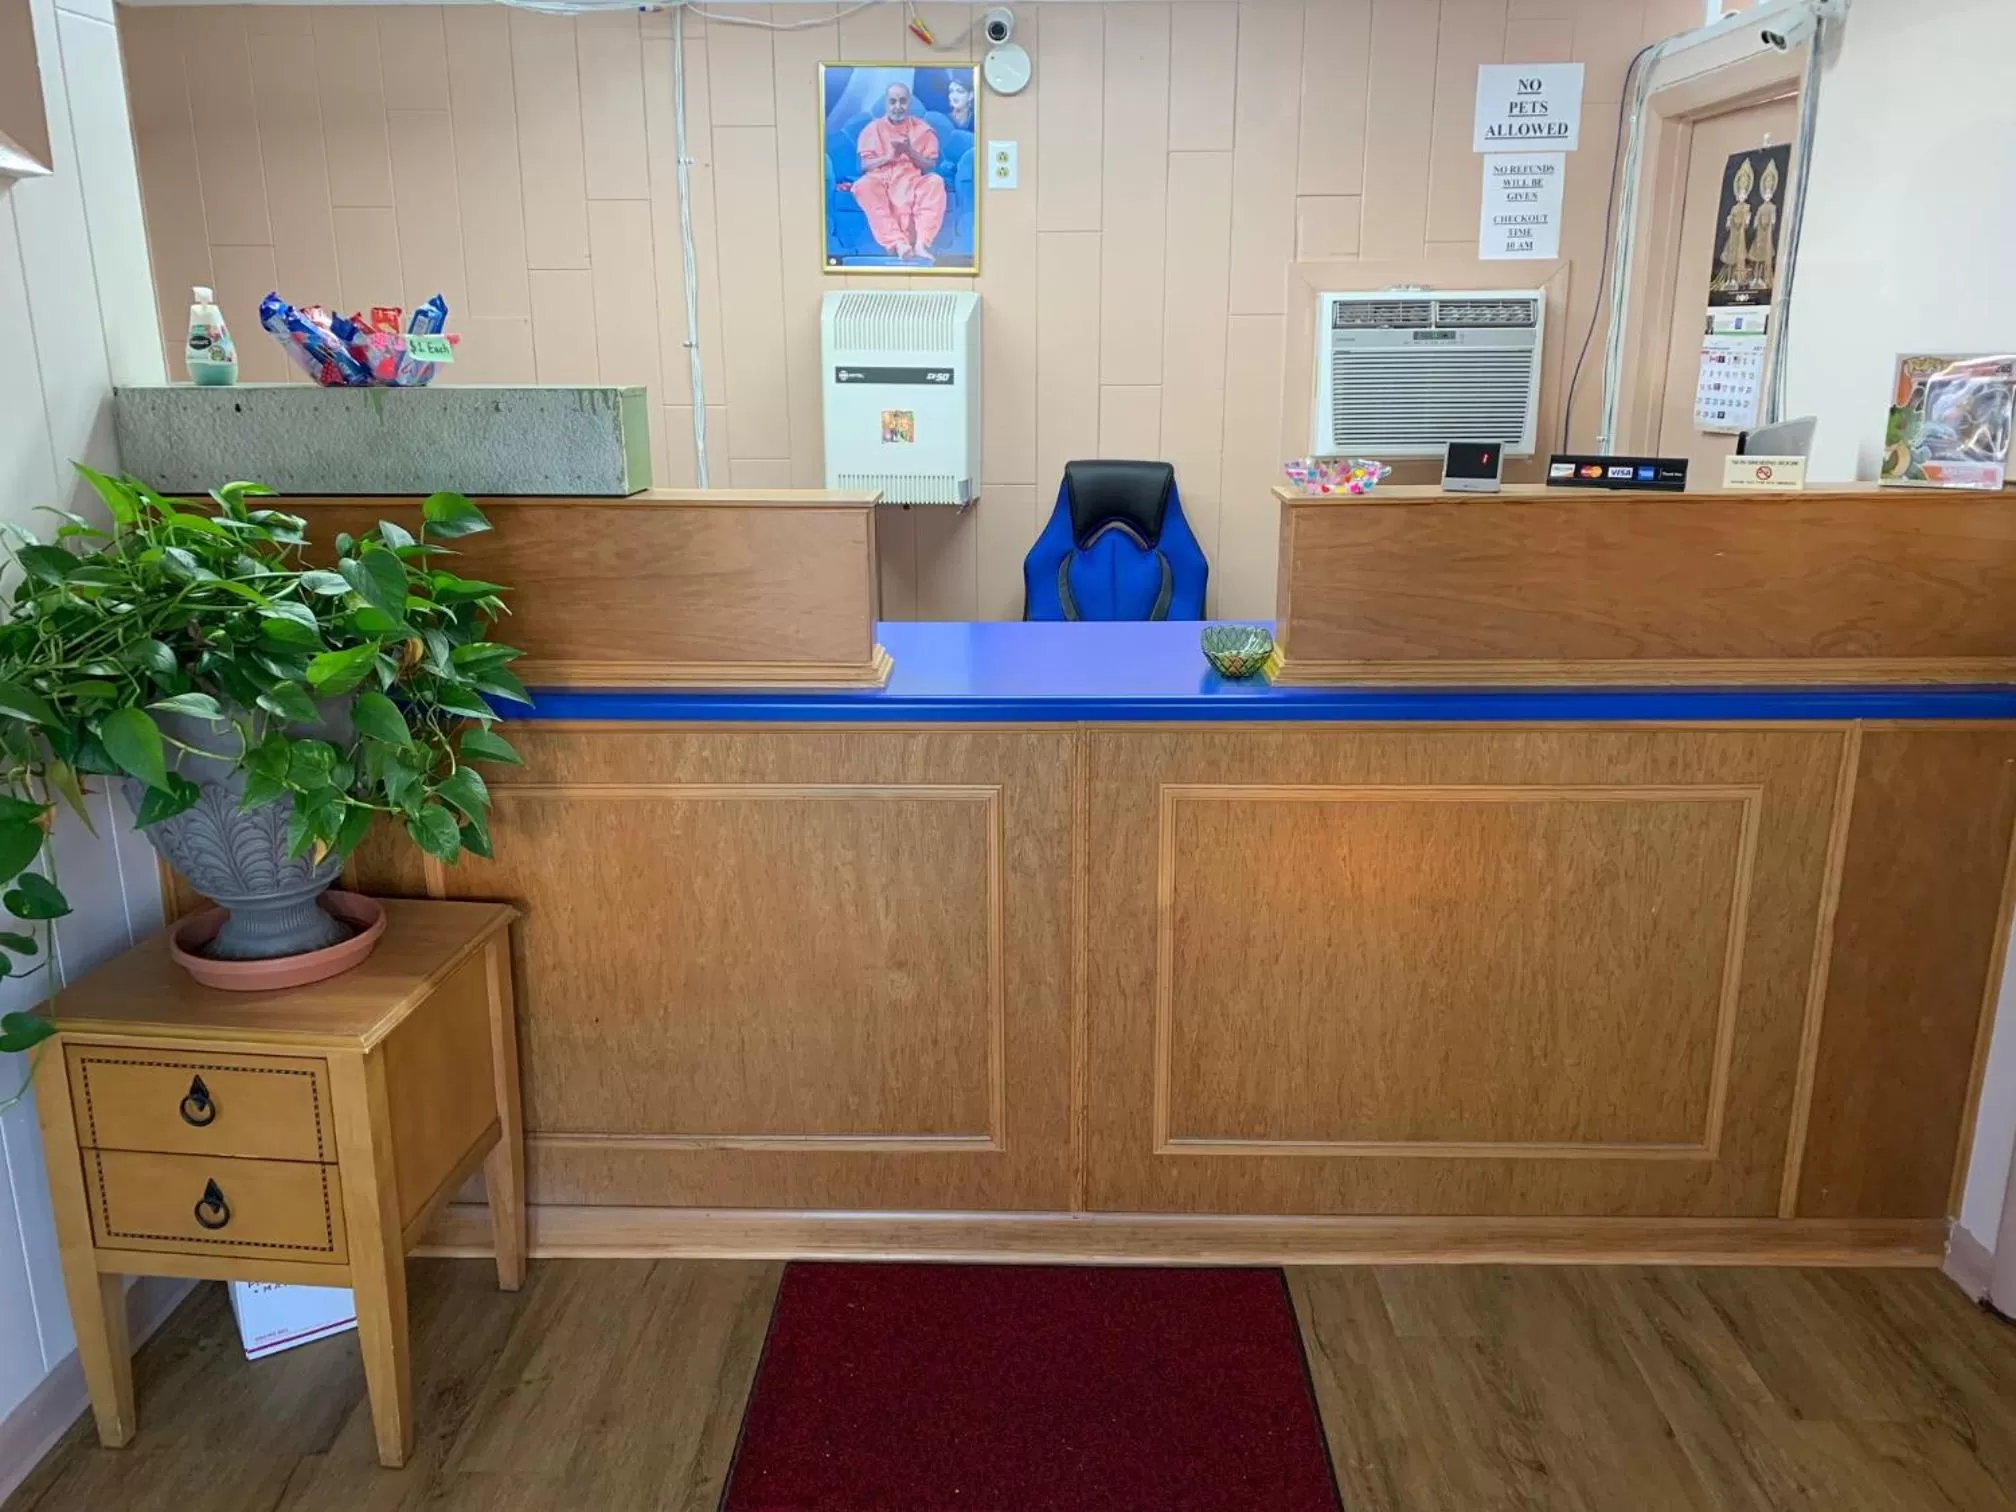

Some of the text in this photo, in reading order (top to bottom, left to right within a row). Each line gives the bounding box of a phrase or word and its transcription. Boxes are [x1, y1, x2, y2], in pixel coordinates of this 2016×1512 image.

[1518, 78, 1542, 93] NO
[1508, 101, 1549, 115] PETS
[1485, 122, 1569, 138] ALLOWED
[1493, 164, 1555, 174] NO REFUNDS
[1503, 178, 1544, 188] WILL BE
[1506, 192, 1538, 201] GIVEN
[1493, 214, 1548, 224] CHECKOUT
[1507, 228, 1533, 237] TIME
[1517, 241, 1533, 250] AM
[427, 341, 450, 354] Each
[1611, 467, 1631, 477] VISA
